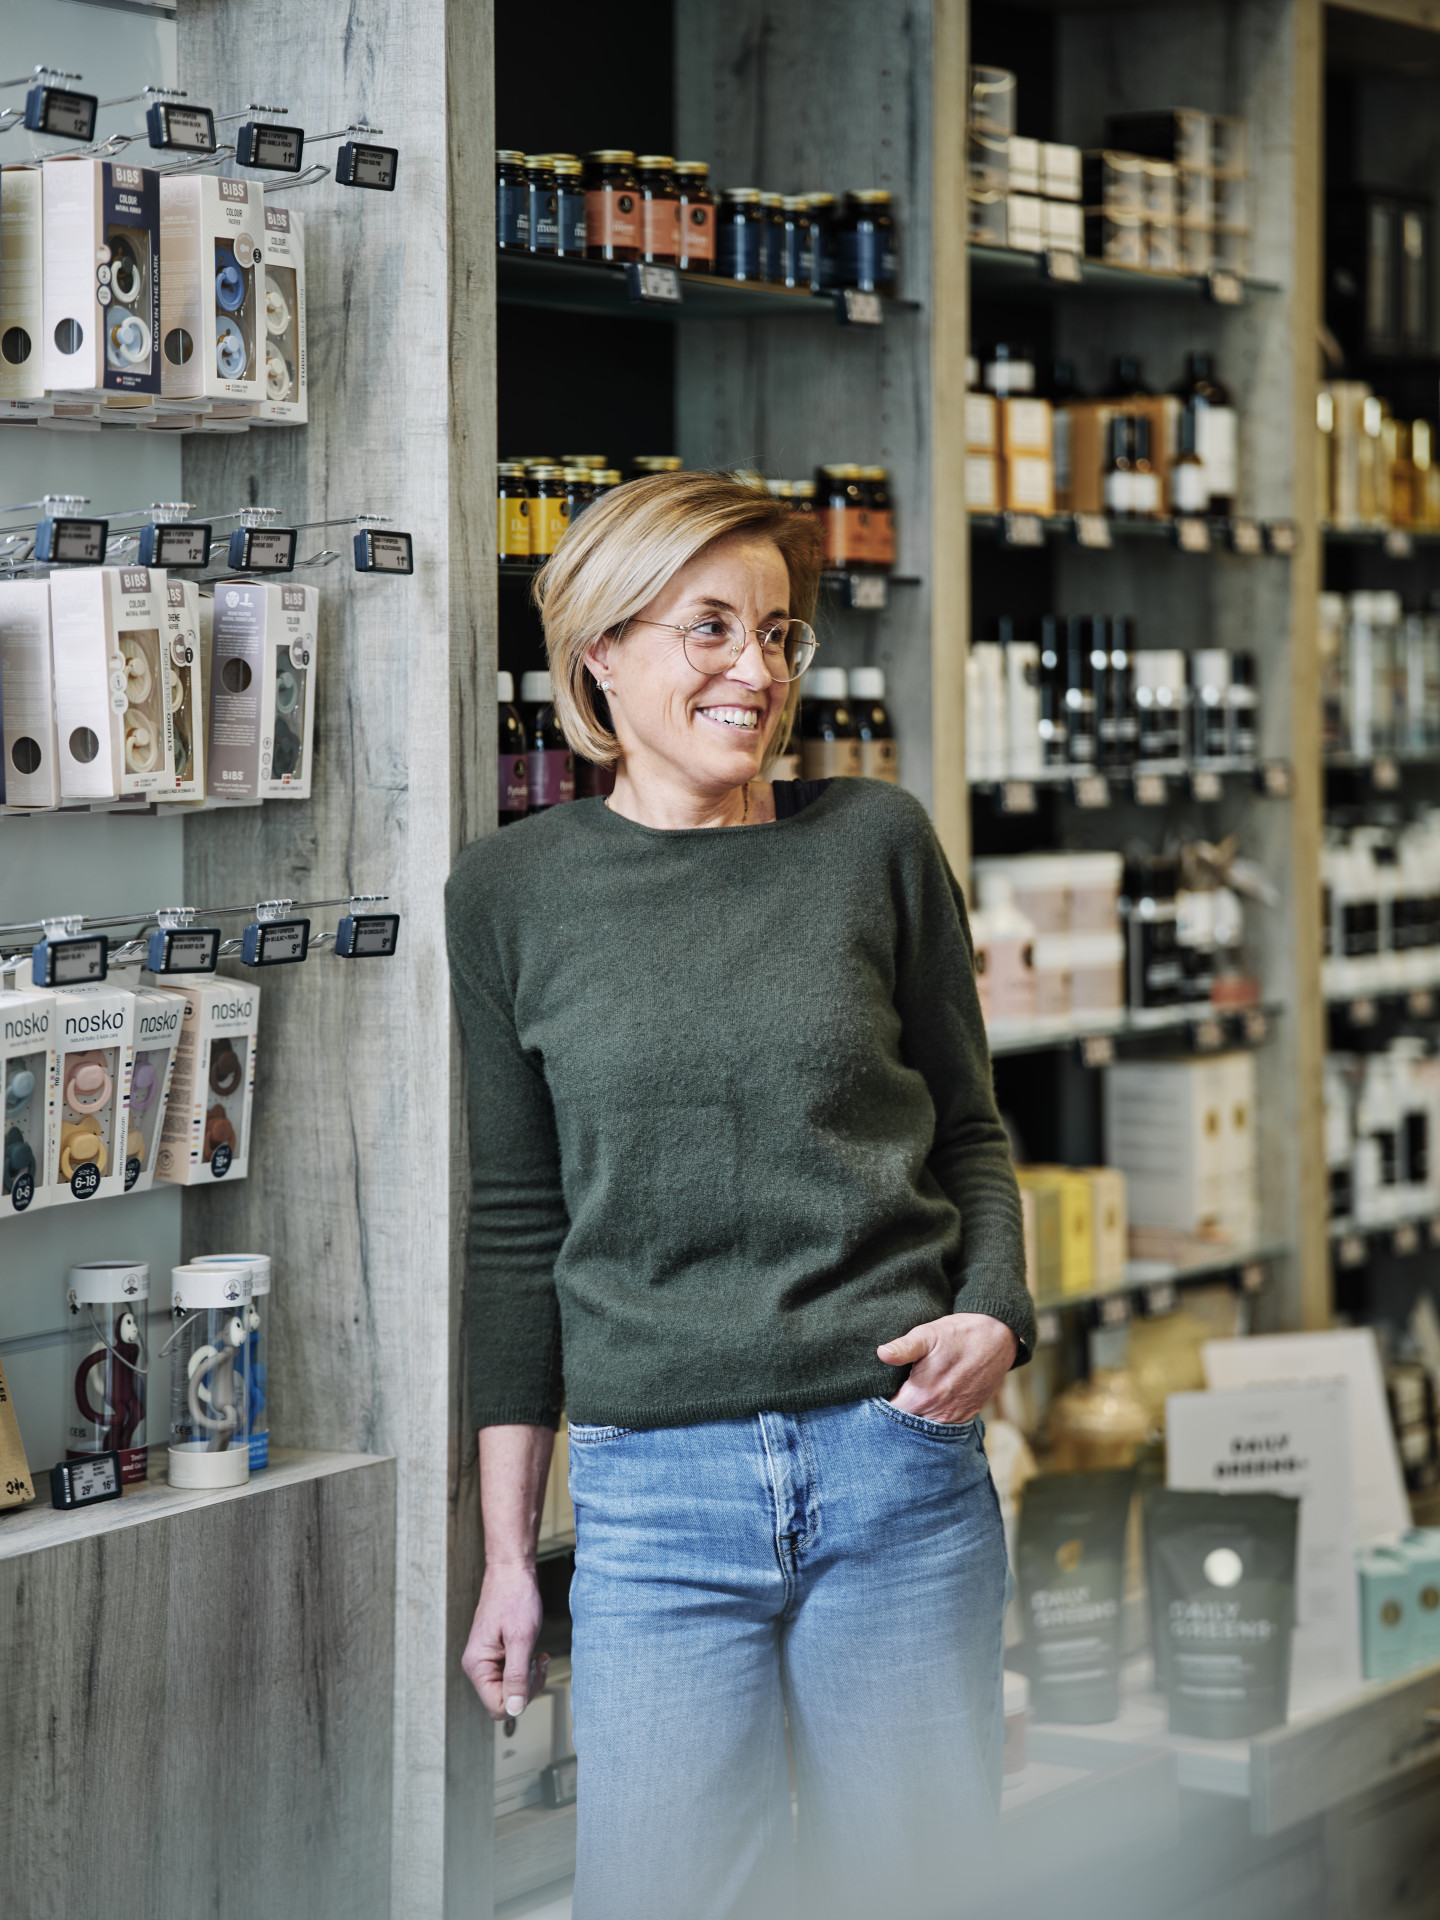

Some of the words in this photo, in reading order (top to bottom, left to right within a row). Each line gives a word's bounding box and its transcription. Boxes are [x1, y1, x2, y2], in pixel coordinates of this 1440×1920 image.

[116, 168, 139, 184] BIBS
[222, 182, 244, 197] BIBS
[226, 208, 242, 217] COLOUR
[267, 213, 287, 227] BIBS
[154, 308, 159, 319] IN
[124, 573, 146, 588] BIBS
[129, 600, 146, 608] COLOUR
[284, 593, 303, 605] BIBS
[222, 771, 242, 780] BIBS
[212, 999, 252, 1020] nosko
[5, 1012, 49, 1039] nosko
[66, 1010, 124, 1034] nosko
[140, 1011, 178, 1034] nosko
[75, 1175, 96, 1188] 6-18
[16, 1186, 30, 1200] 0-6
[1168, 1602, 1239, 1621] DAILY
